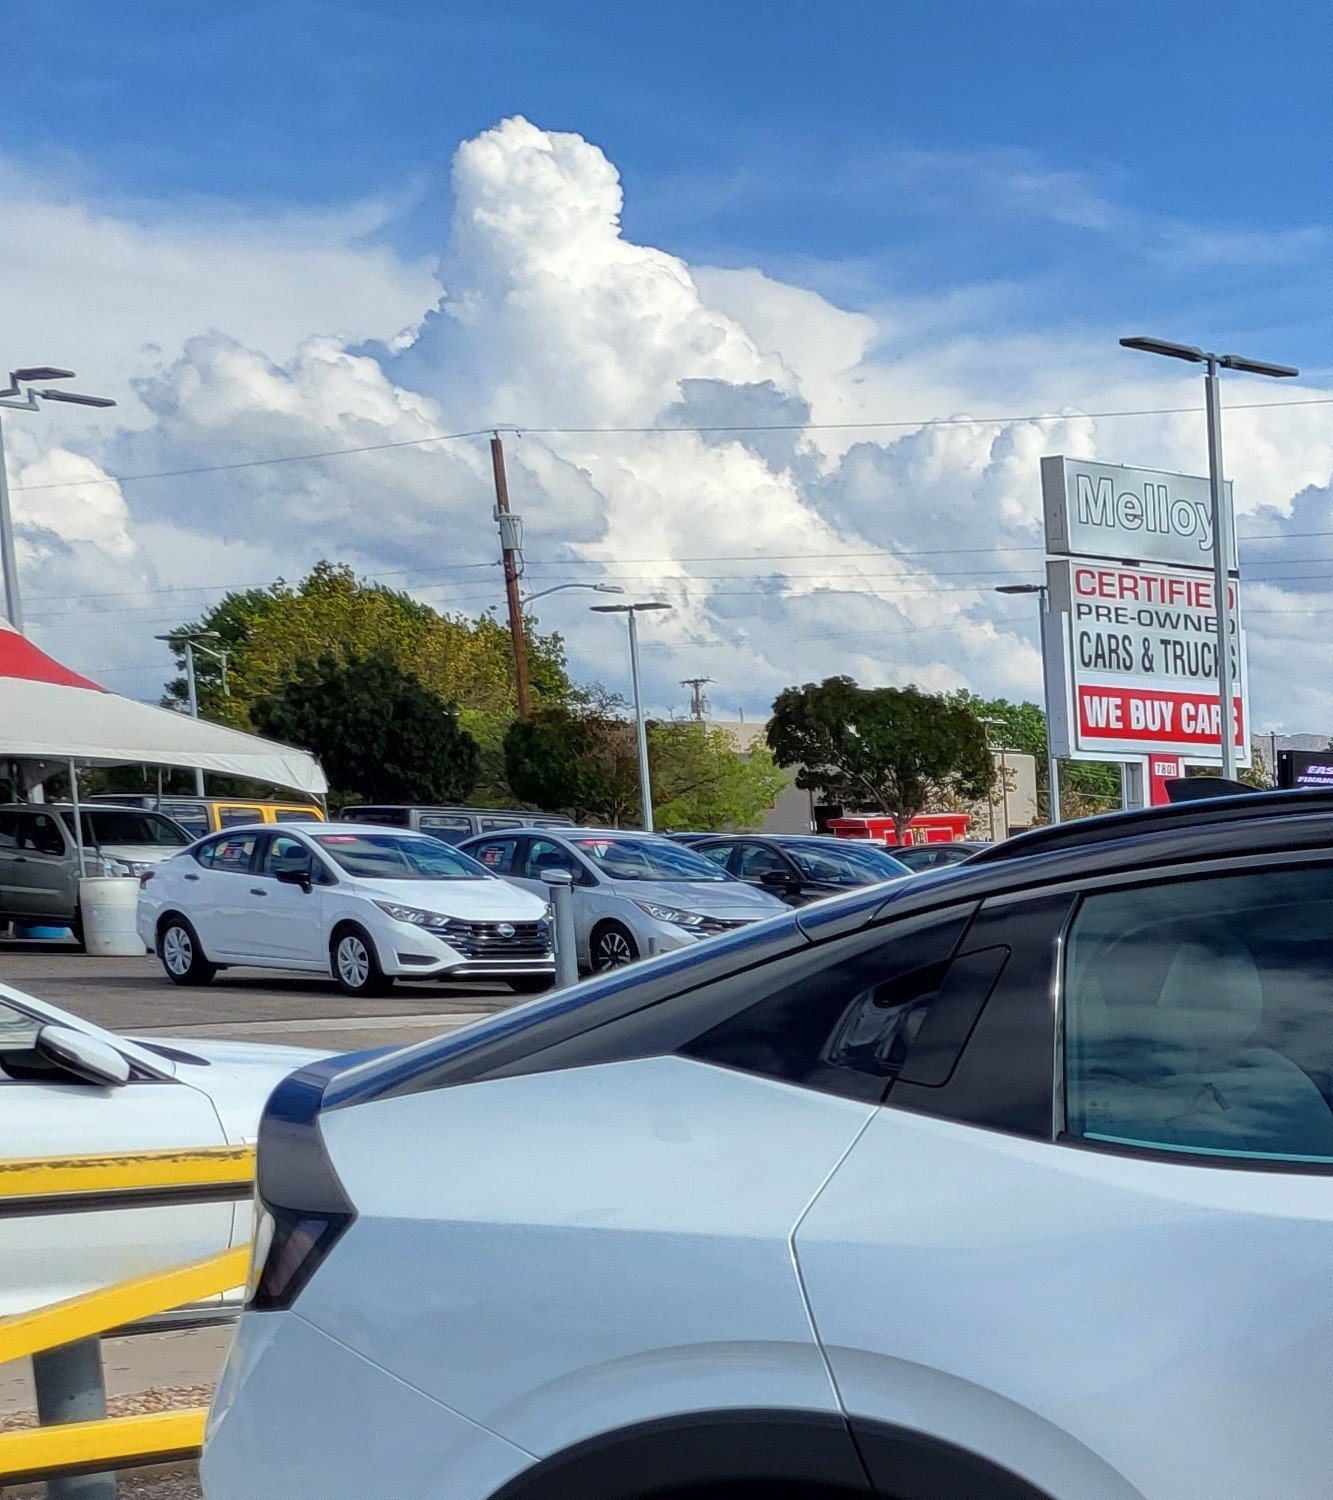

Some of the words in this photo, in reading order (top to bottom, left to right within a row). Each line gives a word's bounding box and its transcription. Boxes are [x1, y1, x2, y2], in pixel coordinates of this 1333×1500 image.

[1076, 474, 1215, 551] Melloy
[1079, 630, 1134, 672] CARS
[1141, 637, 1155, 673] &
[1083, 695, 1124, 729] WE
[1130, 698, 1174, 732] BUY
[1155, 763, 1177, 775] 7801
